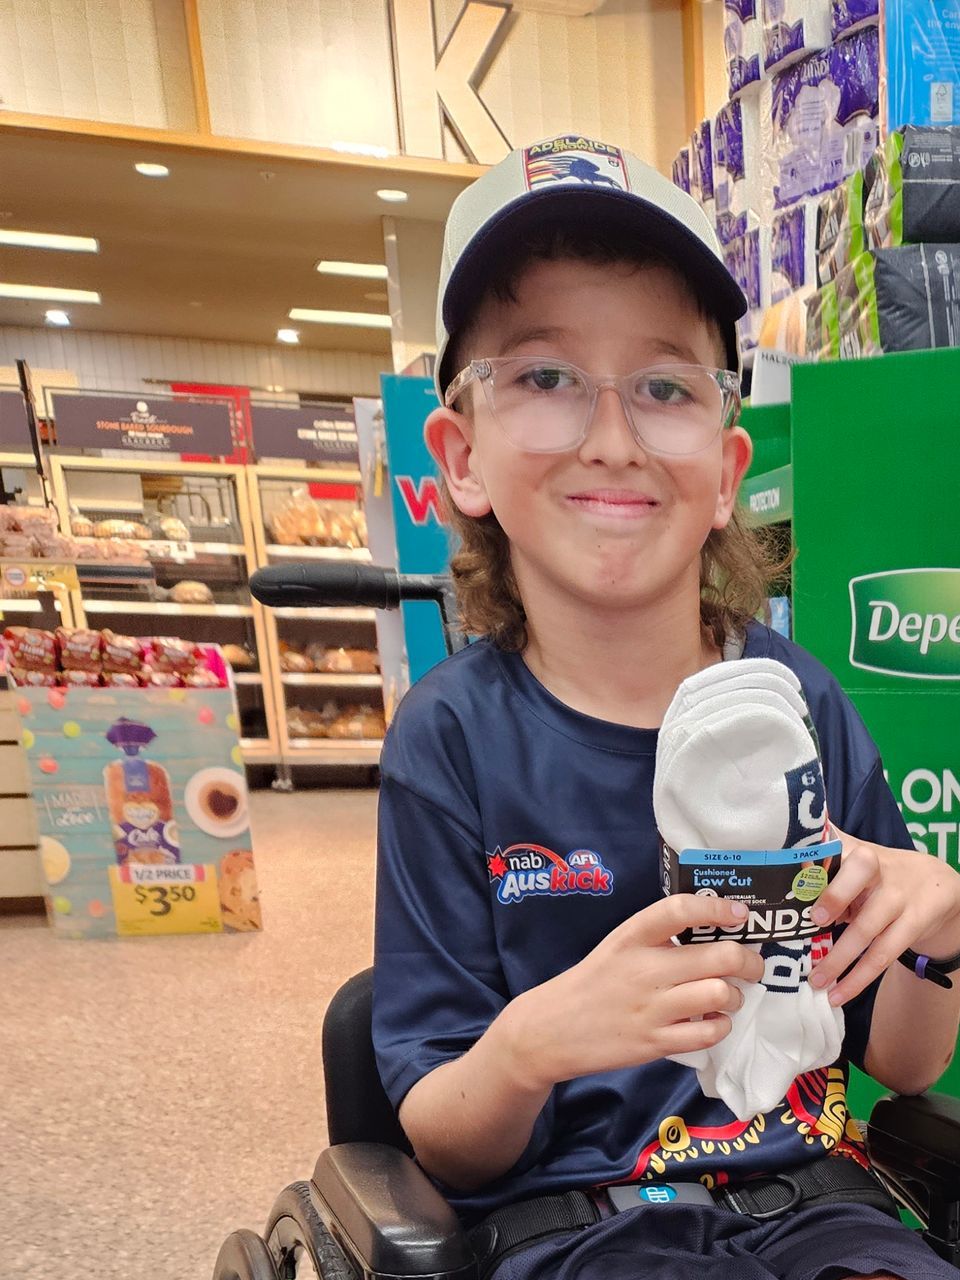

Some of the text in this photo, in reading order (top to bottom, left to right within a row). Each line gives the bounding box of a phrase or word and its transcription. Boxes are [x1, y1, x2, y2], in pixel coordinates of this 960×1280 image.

[530, 138, 618, 156] ADELAIDE
[800, 850, 819, 858] PACK
[509, 853, 599, 870] nab AFL
[135, 869, 191, 880] 1/2 PRICE
[694, 876, 752, 886] Low Cut
